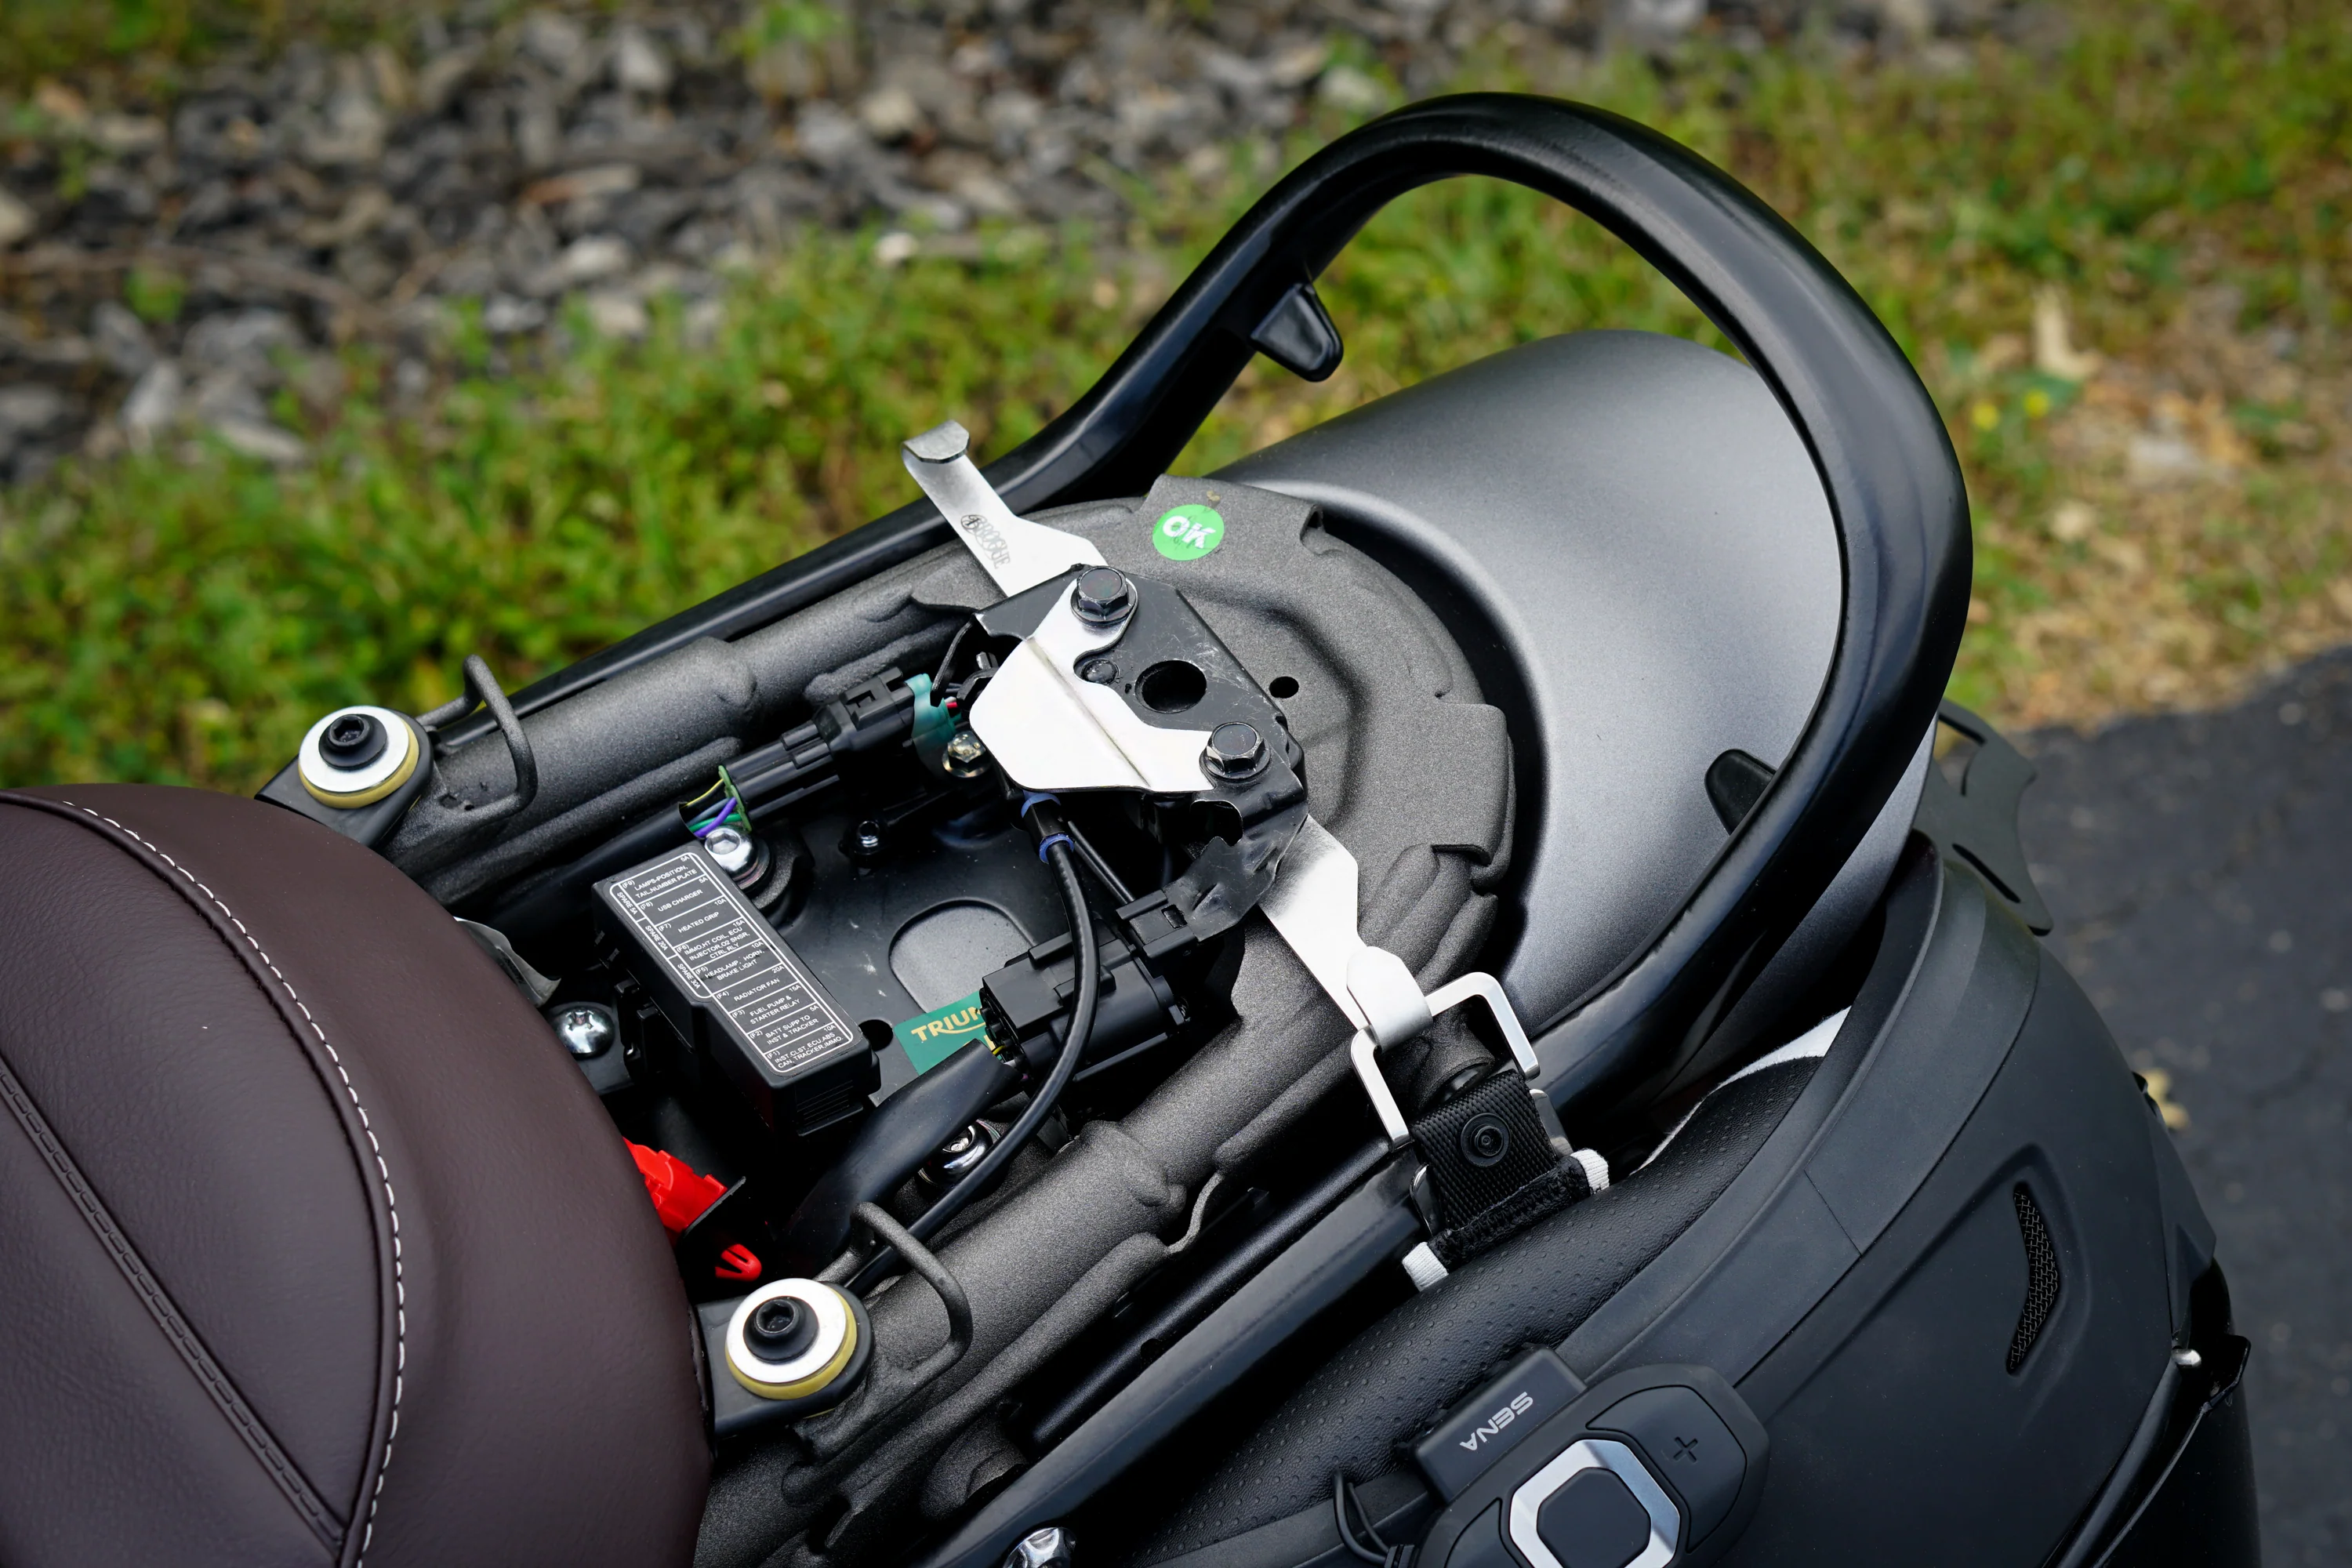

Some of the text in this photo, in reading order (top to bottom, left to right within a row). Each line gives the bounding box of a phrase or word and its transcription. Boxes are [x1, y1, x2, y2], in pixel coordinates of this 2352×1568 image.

[1163, 515, 1216, 549] OK
[677, 869, 698, 880] PLATE
[622, 880, 635, 888] (F9)
[617, 891, 633, 909] SPARE
[640, 901, 653, 910] (F8)
[657, 889, 703, 912] USB CHARGER
[659, 923, 672, 932] (F7)
[677, 911, 720, 933] HEATED GRIP
[728, 927, 742, 935] ECU
[645, 925, 668, 951] SPARE 20A
[676, 944, 690, 953] (F6)
[710, 942, 739, 959] CTRL RLY
[742, 949, 765, 961] HORN,
[695, 966, 709, 975] (F5)
[717, 959, 757, 981] BRAKE LIGHT
[771, 965, 785, 974] 20A
[677, 964, 701, 989] SPARE 30A
[734, 978, 780, 1002] RADIATOR FAN
[789, 984, 801, 993] 15A
[716, 990, 730, 1000] (F4)
[750, 1007, 768, 1017] FUEL
[767, 997, 786, 1009] PUMP
[750, 998, 800, 1025] STARTER RELAY
[731, 1009, 746, 1018] (F3)
[764, 1014, 811, 1039] BATT SUPP TO
[767, 1036, 782, 1045] INST
[788, 1018, 819, 1035] TRACKER
[750, 1030, 764, 1039] (F2)
[767, 1050, 781, 1060] (F1)
[778, 1059, 795, 1069] CAN,
[1460, 1392, 1534, 1450] SENA
